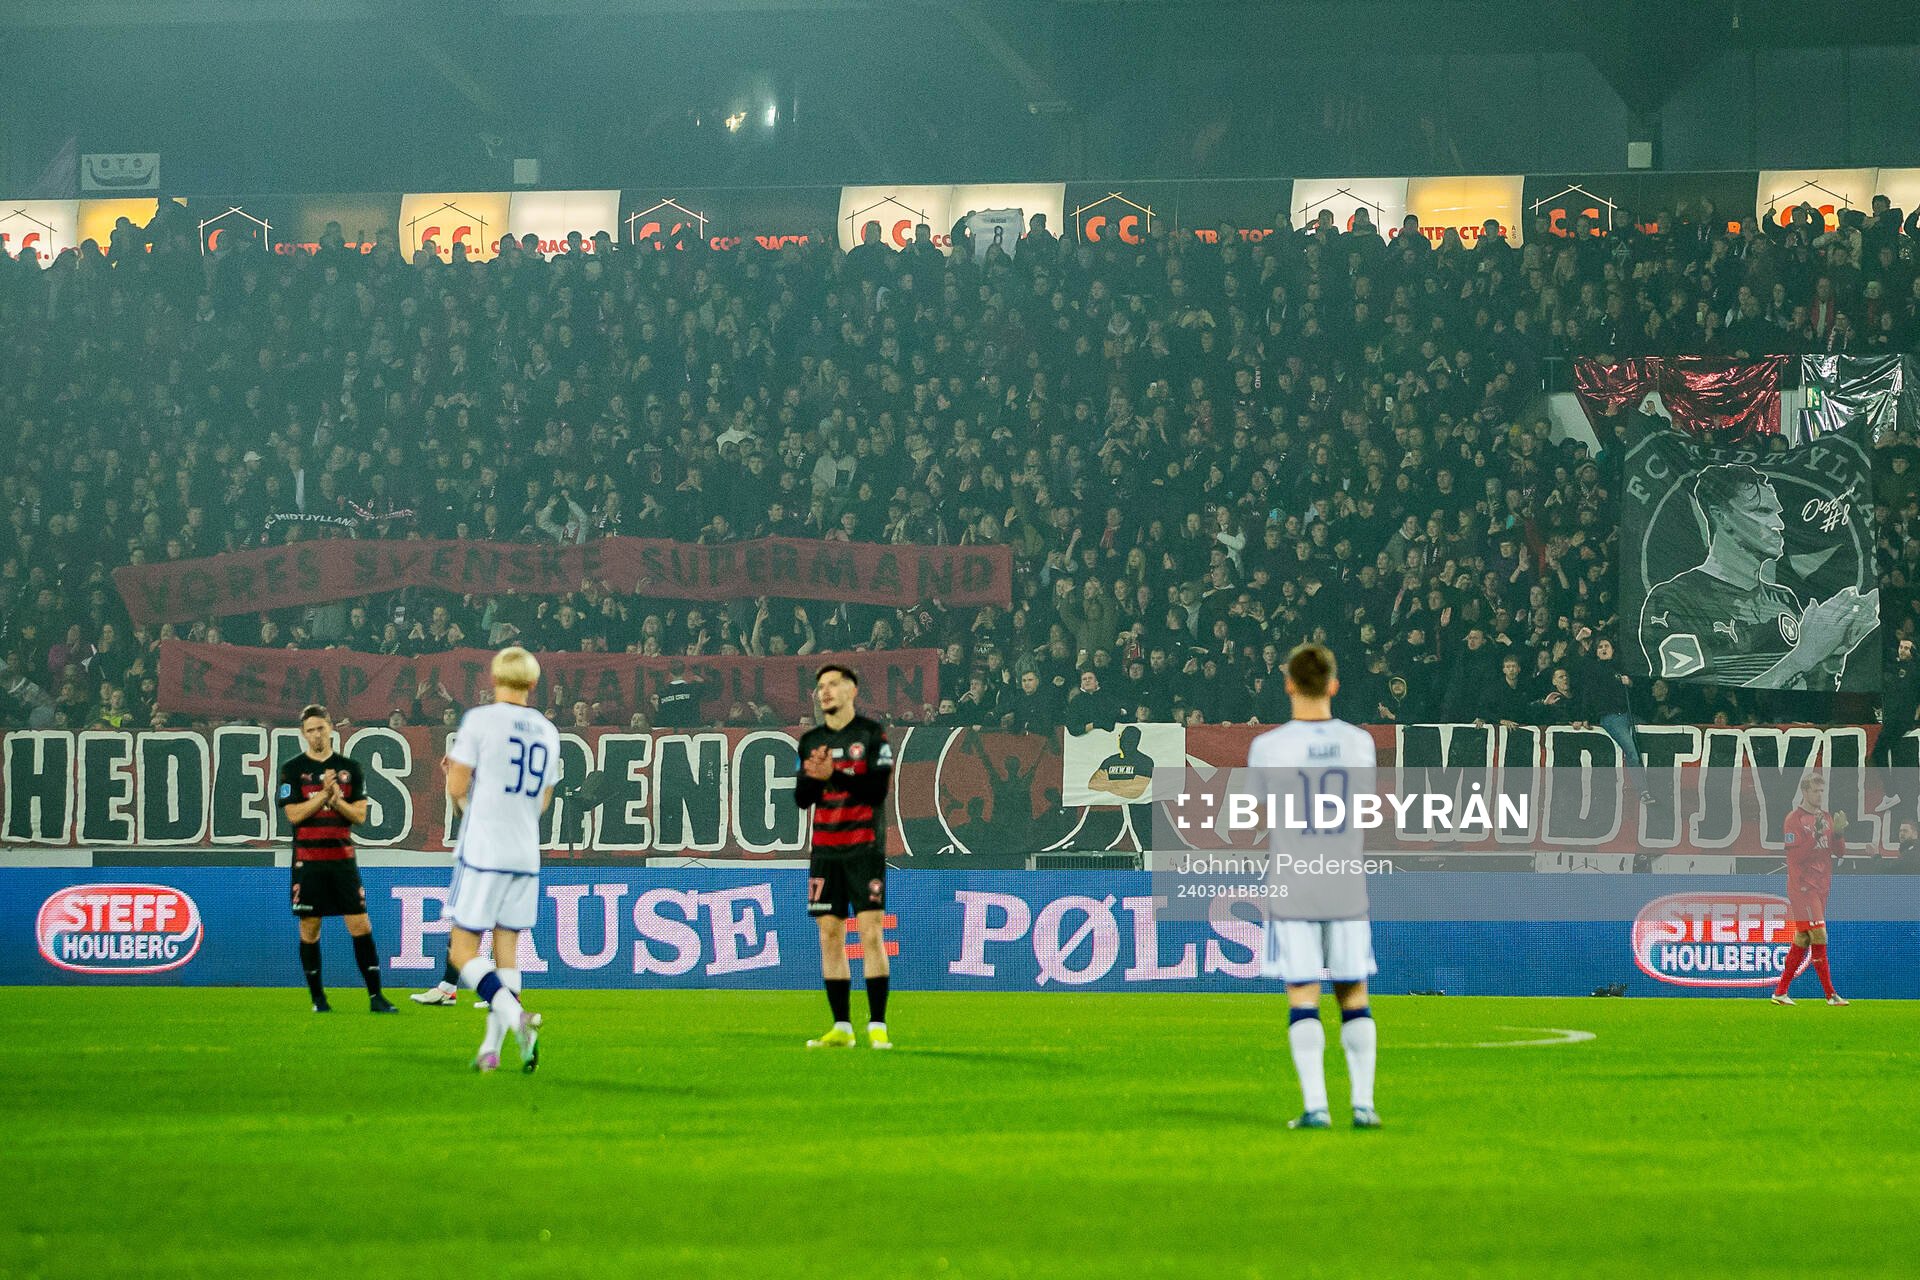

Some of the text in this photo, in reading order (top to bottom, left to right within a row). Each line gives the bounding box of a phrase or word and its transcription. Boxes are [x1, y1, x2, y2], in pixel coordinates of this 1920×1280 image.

[274, 513, 354, 528] MIDTJYLLAN
[1819, 503, 1851, 533] #8
[140, 543, 997, 615] VORES SVENSKE SUPERMAND
[504, 736, 549, 799] 39
[65, 894, 179, 933] STEFF
[1658, 902, 1788, 943] STEFF
[62, 933, 180, 961] HOULBERG
[948, 889, 1333, 987] PØLS
[1660, 944, 1791, 972] HOULBERG
